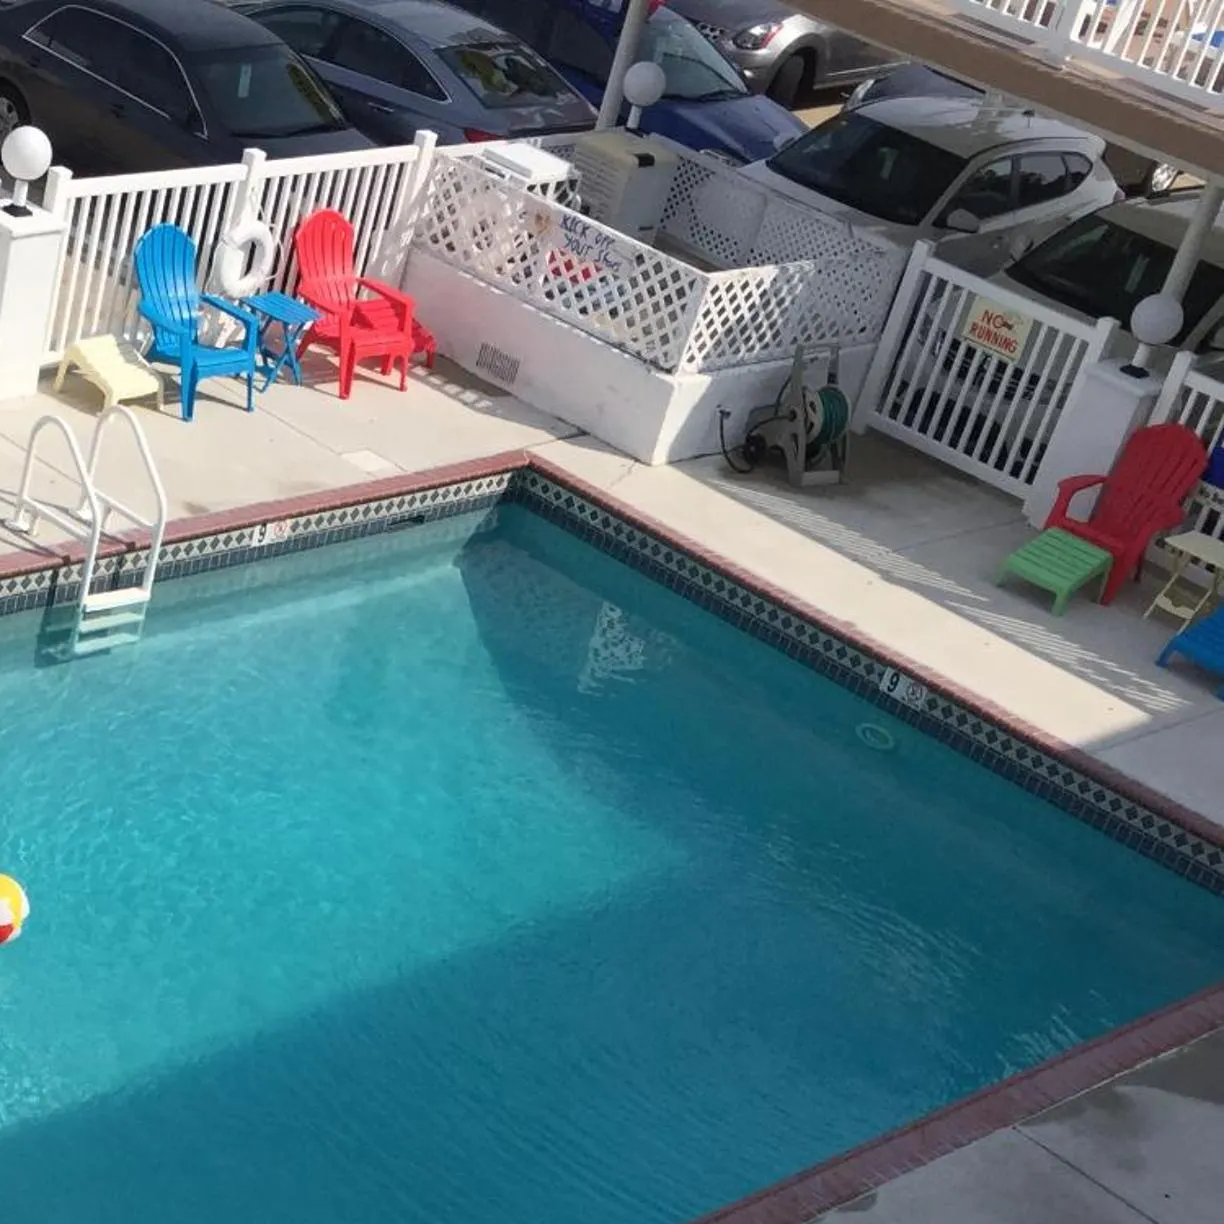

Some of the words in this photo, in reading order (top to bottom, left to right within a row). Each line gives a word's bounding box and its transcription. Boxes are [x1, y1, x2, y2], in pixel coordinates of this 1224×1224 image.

[981, 309, 1004, 329] NO
[969, 321, 1018, 353] RUNNING
[887, 672, 900, 692] 9
